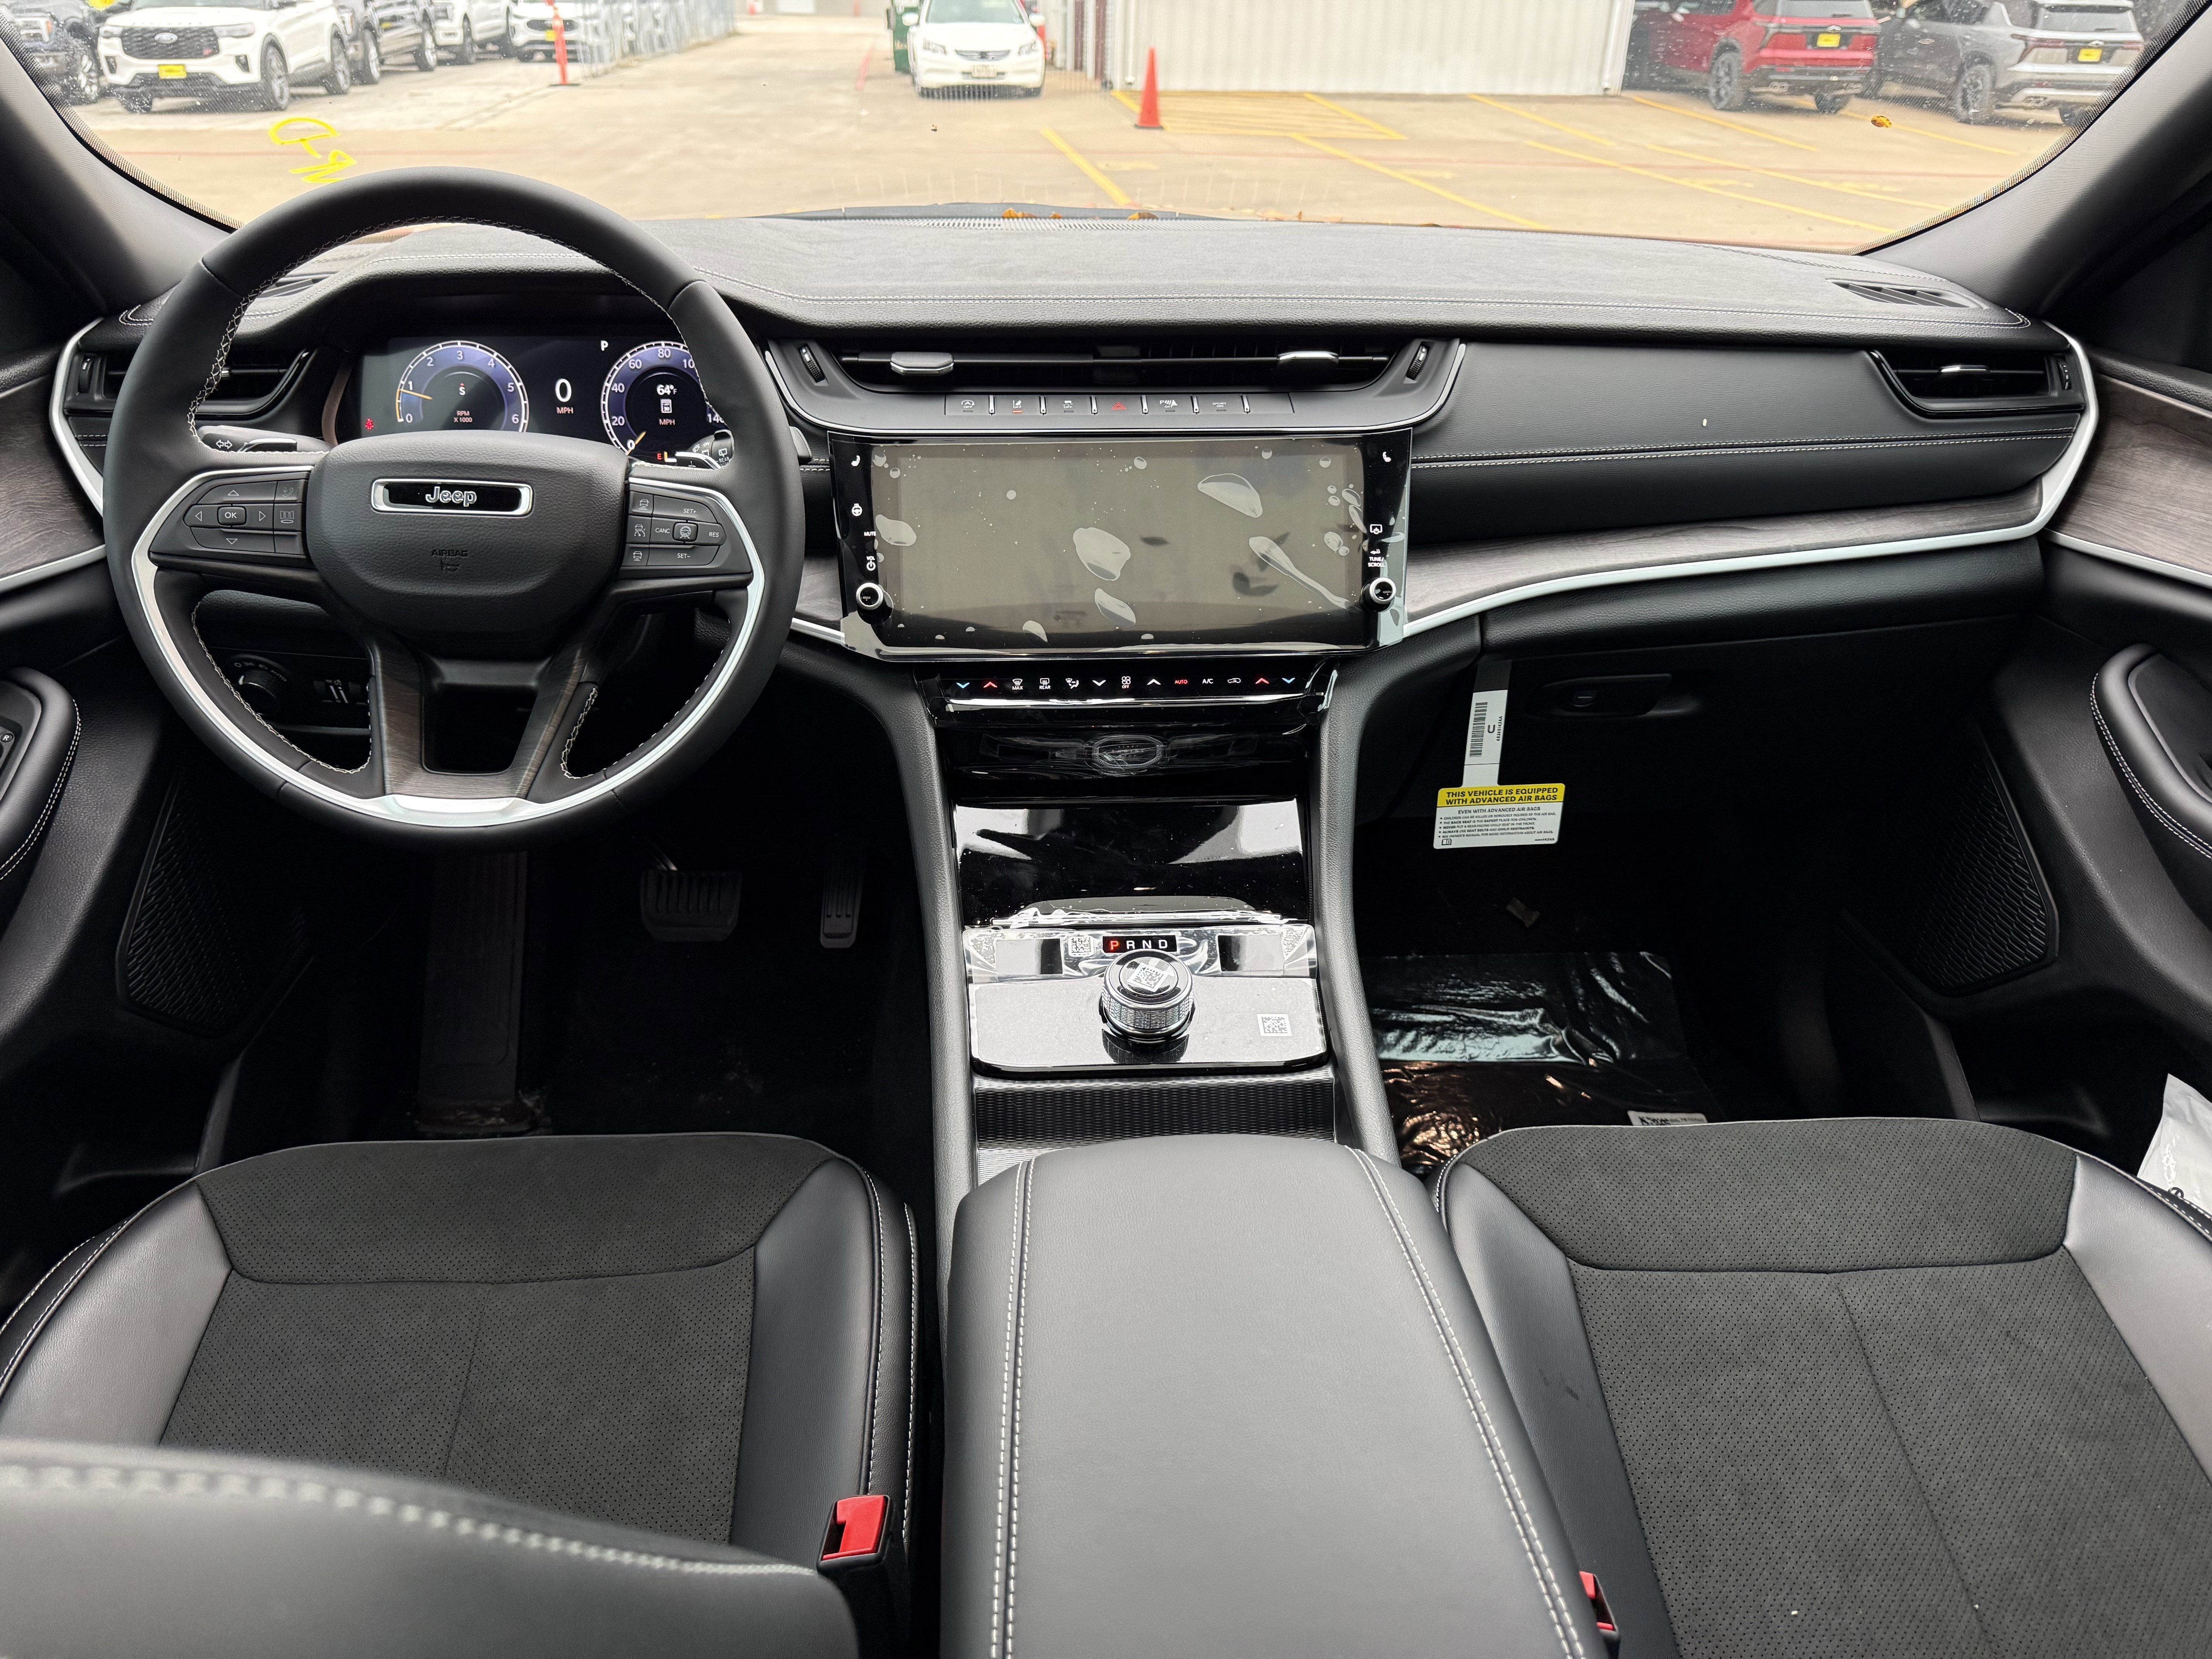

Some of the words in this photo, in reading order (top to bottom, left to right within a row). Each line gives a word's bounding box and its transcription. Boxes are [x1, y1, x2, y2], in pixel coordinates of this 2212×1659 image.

[601, 340, 608, 350] P
[457, 350, 463, 360] 3
[658, 349, 671, 359] 80
[427, 357, 434, 367] 2
[488, 358, 495, 368] 4
[629, 359, 642, 369] 60
[683, 359, 695, 368] 10
[408, 381, 413, 390] 1
[507, 383, 515, 392] 5
[555, 378, 572, 402] 0
[611, 383, 625, 393] 40
[405, 413, 413, 423] 0
[512, 414, 519, 424] 6
[611, 416, 625, 426] 20
[627, 439, 635, 450] 0
[425, 486, 477, 507] Jeep
[431, 549, 469, 558] AIRBAG
[1110, 940, 1118, 950] P
[1126, 940, 1135, 949] R
[1142, 940, 1152, 949] N
[1158, 939, 1168, 949] D
